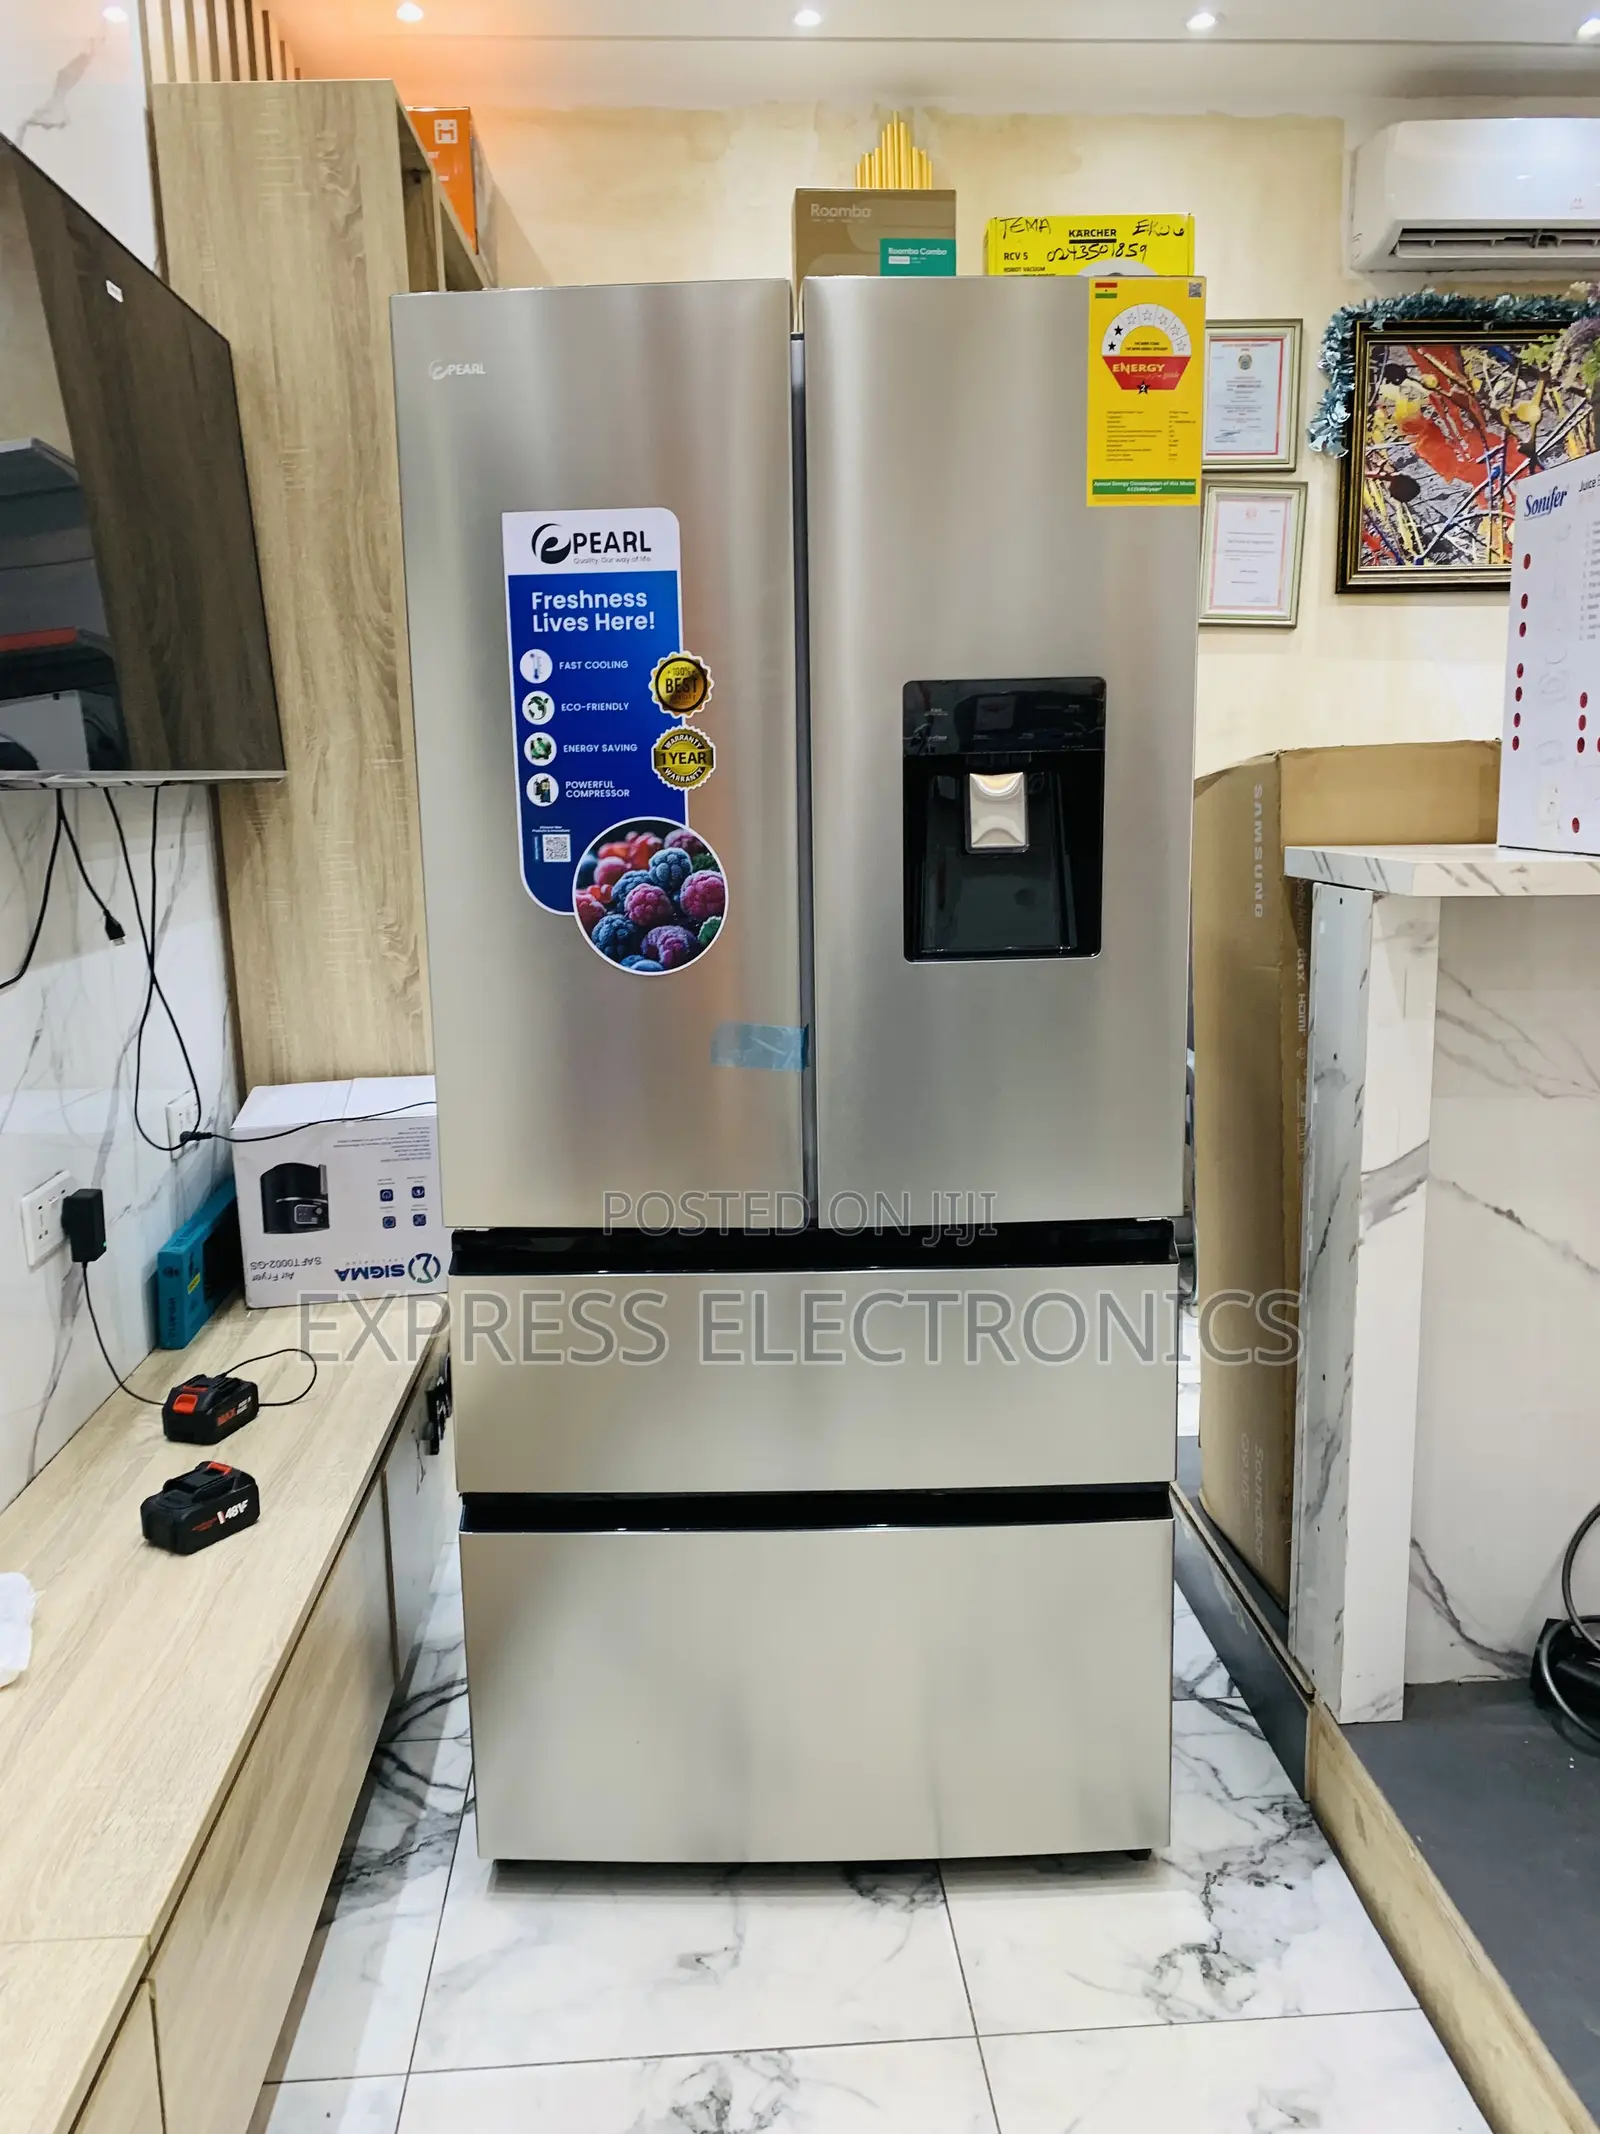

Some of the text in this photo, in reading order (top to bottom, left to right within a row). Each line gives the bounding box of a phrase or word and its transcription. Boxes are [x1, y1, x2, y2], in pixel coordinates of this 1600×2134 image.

[810, 203, 872, 218] Roomba
[1000, 216, 1051, 240] TEMA
[888, 247, 947, 255] Roomba Combo
[1003, 252, 1028, 261] RCV 5
[1112, 361, 1166, 375] ENERGY
[1524, 485, 1568, 517] Sonifer
[572, 530, 652, 555] PEARL
[531, 589, 648, 610] Freshness
[533, 611, 655, 633] Lives Here!
[559, 660, 629, 670] FAST COOLING
[665, 677, 698, 694] BEST
[561, 702, 629, 712] ECO-FRIENDLY
[563, 743, 638, 753] ENERGY SAVING
[664, 734, 702, 749] WARRANTY
[661, 752, 707, 765] 1 YEAR
[664, 768, 703, 782] WARRANTY
[565, 780, 615, 790] POWERFUL
[565, 789, 630, 798] COMPRESSOR
[1254, 783, 1264, 918] SAMSUNG
[250, 1256, 322, 1270] SAFT0002-GS
[252, 1271, 295, 1282] Air Fryer
[334, 1263, 406, 1282] SIGMA
